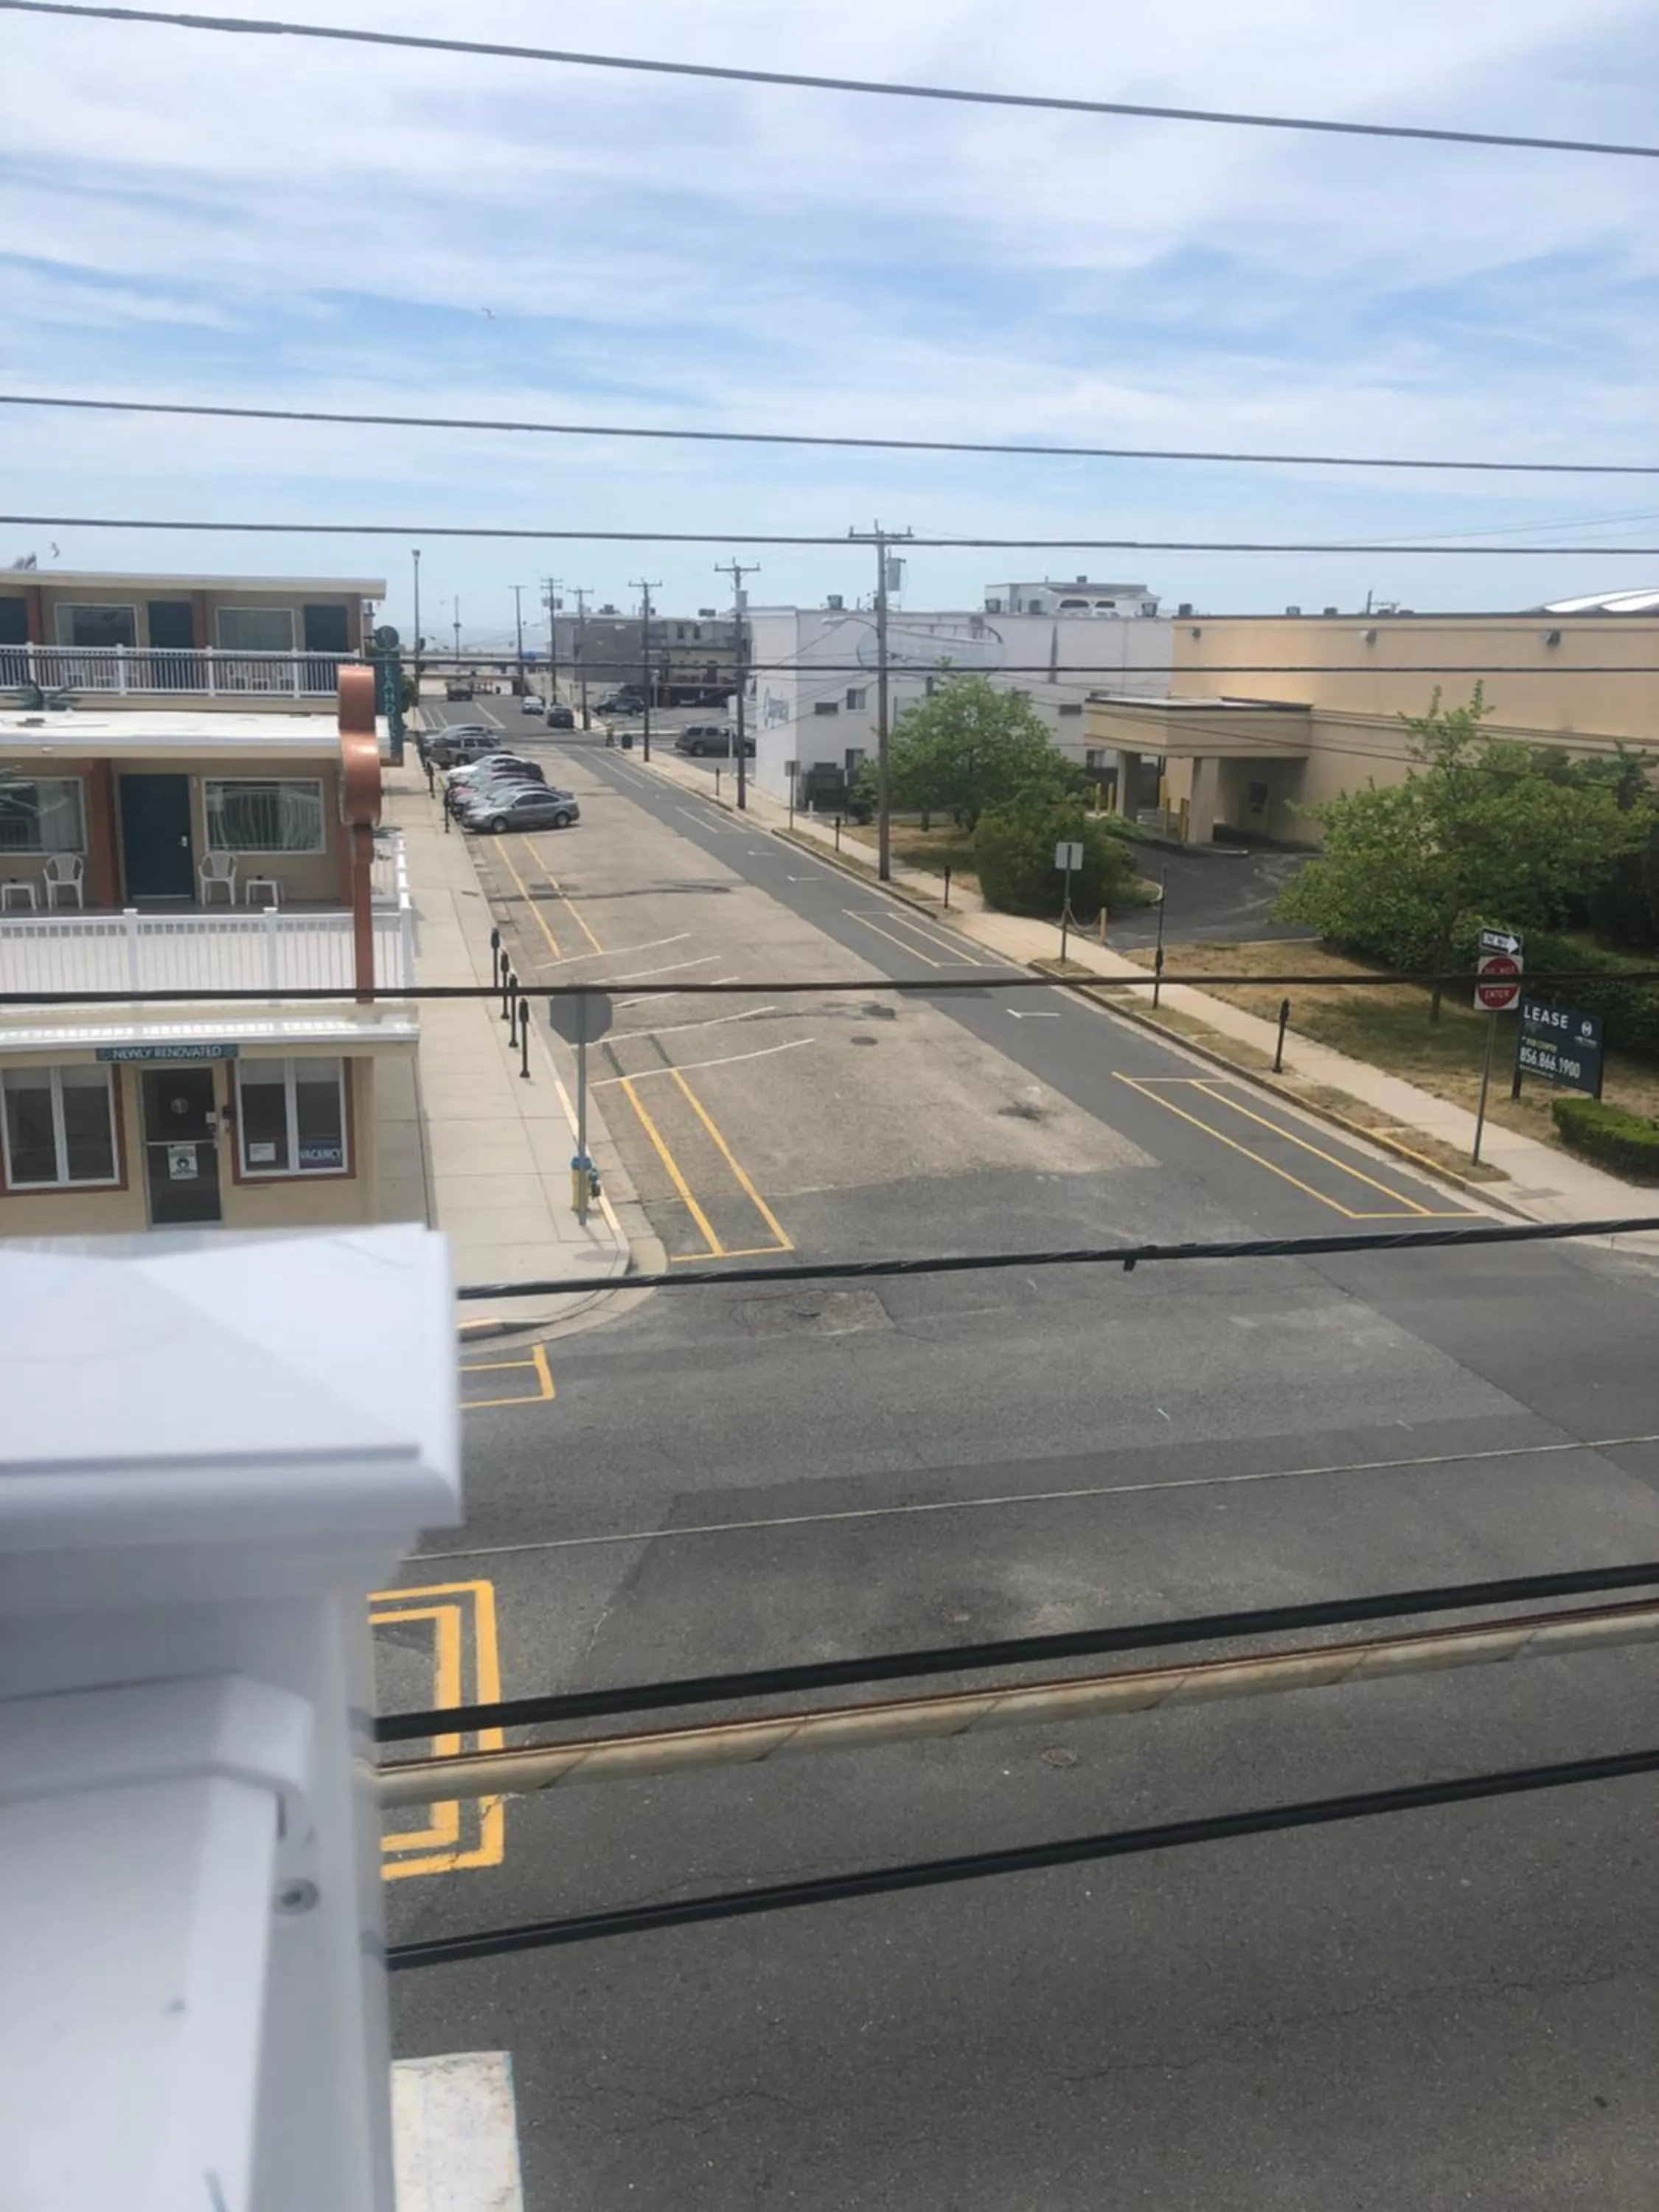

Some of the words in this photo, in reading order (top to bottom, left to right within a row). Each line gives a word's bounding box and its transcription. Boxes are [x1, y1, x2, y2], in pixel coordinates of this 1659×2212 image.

[1523, 1004, 1569, 1029] LEASE
[113, 1048, 150, 1060] NEWLY
[154, 1045, 222, 1057] RENOVATED
